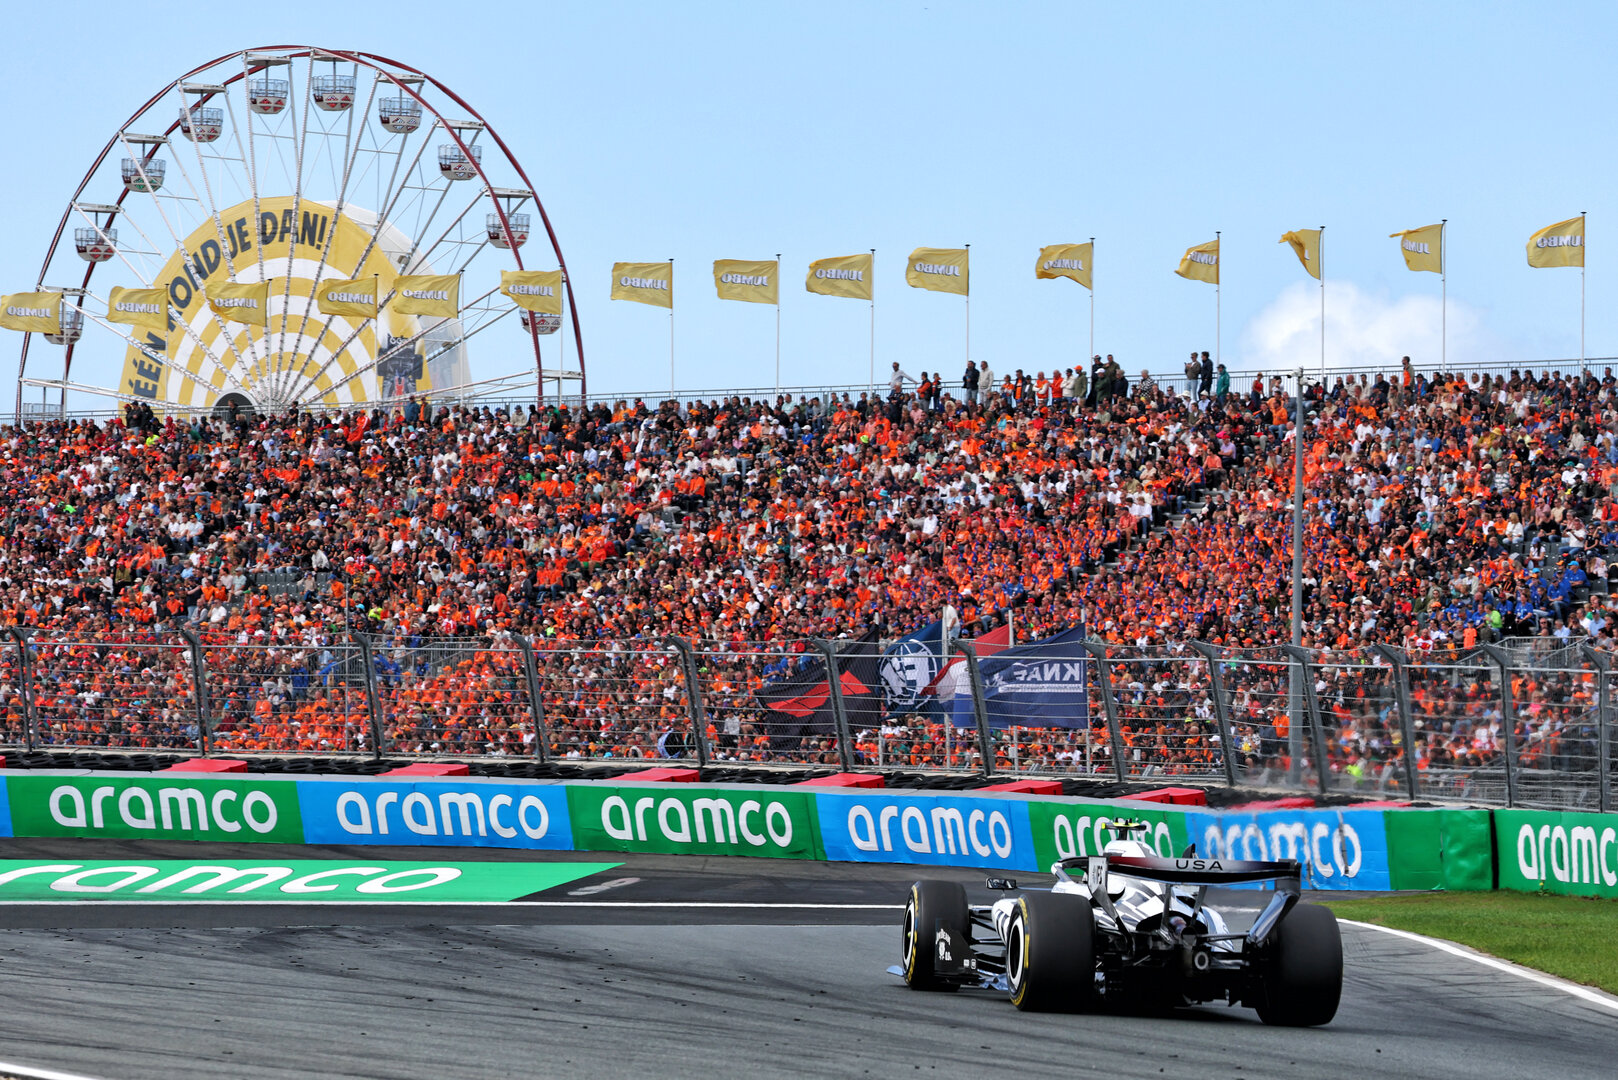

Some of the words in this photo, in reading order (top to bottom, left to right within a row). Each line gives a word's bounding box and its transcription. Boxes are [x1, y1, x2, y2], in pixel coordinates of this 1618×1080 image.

[260, 209, 328, 250] DAN!
[49, 785, 278, 834] aramco
[336, 791, 549, 840] aramco
[601, 795, 793, 848] aramco
[848, 804, 1012, 859] aramco
[1176, 860, 1223, 871] USA
[1517, 824, 1618, 886] aramc
